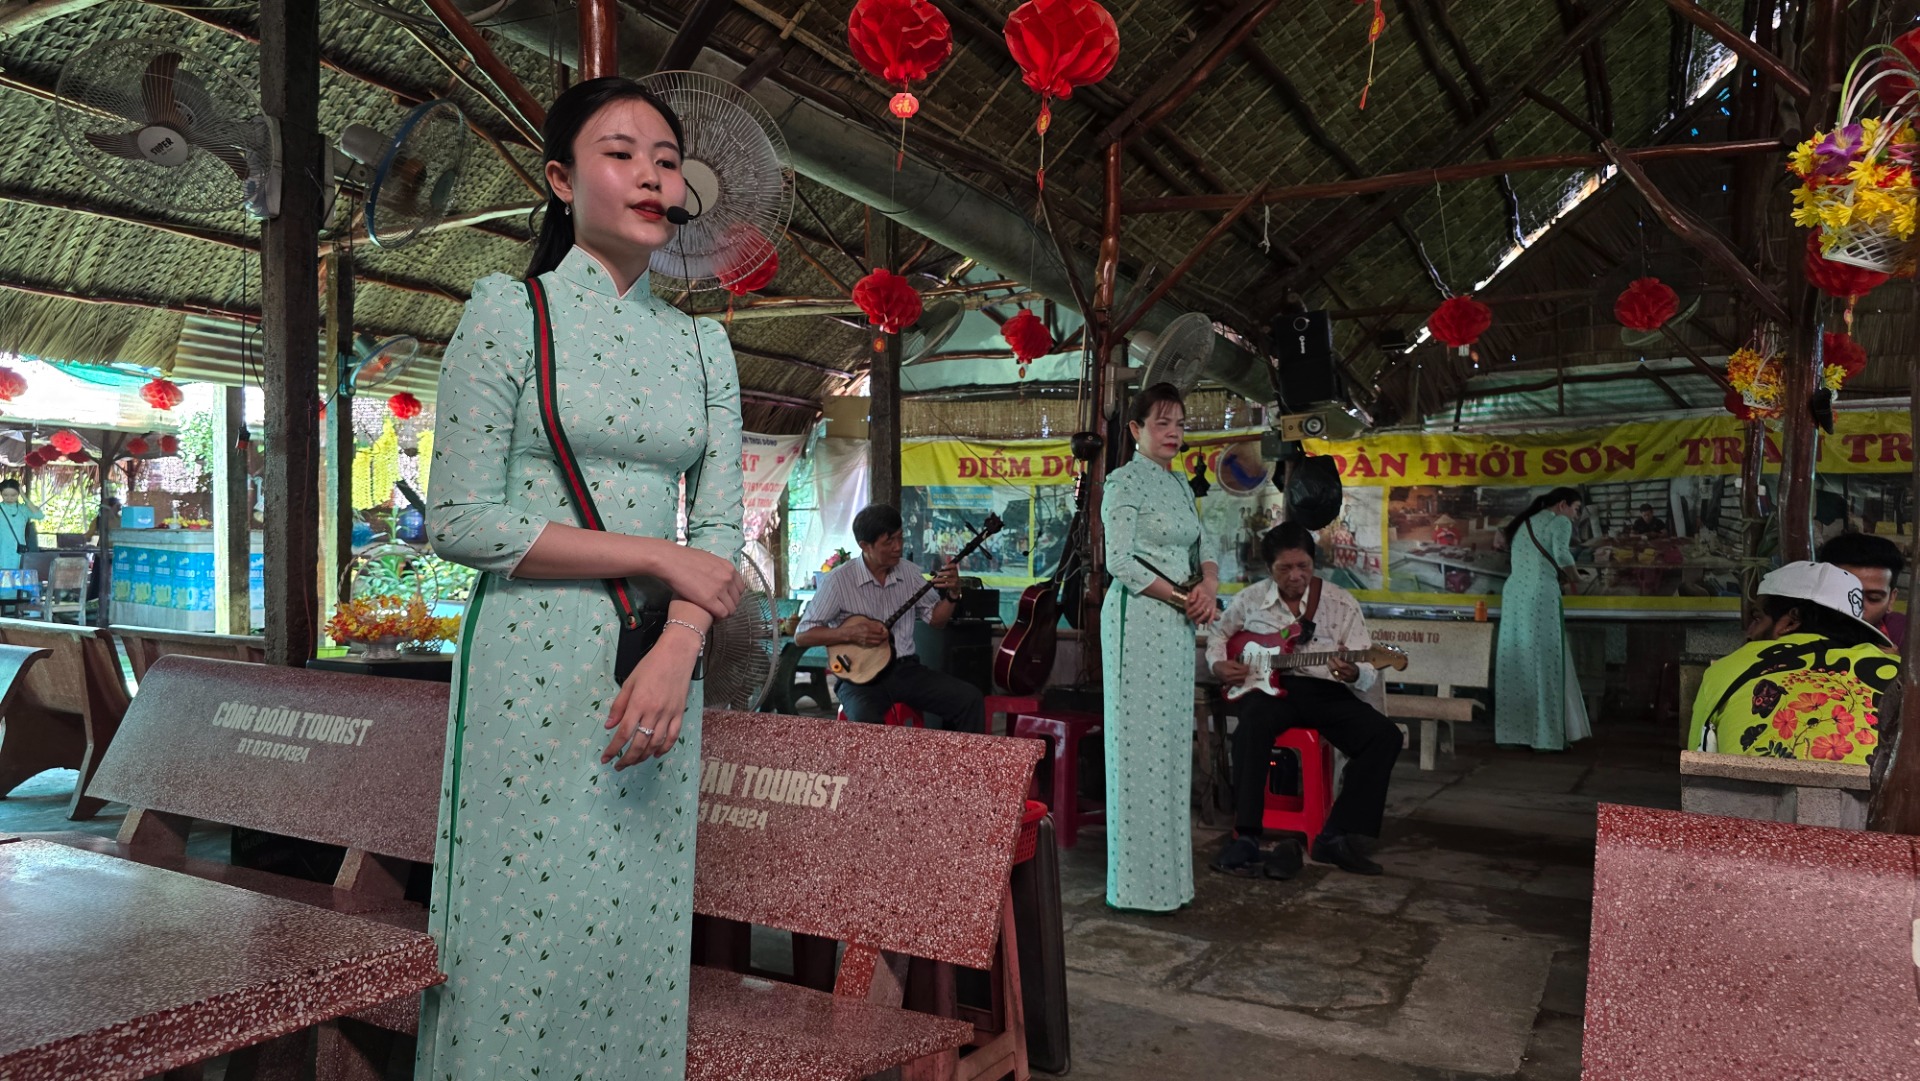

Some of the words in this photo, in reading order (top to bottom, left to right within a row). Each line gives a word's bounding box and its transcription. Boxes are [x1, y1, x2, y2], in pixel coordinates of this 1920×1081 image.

[1420, 444, 1528, 477] THỚI
[1541, 441, 1638, 475] SƠN
[1841, 432, 1913, 463] TR
[212, 700, 257, 731] CÔNG
[252, 704, 301, 737] ĐOÀN
[252, 740, 273, 757] 073
[270, 743, 311, 764] 874324
[700, 756, 739, 796] ÀN
[709, 803, 770, 831] 874324
